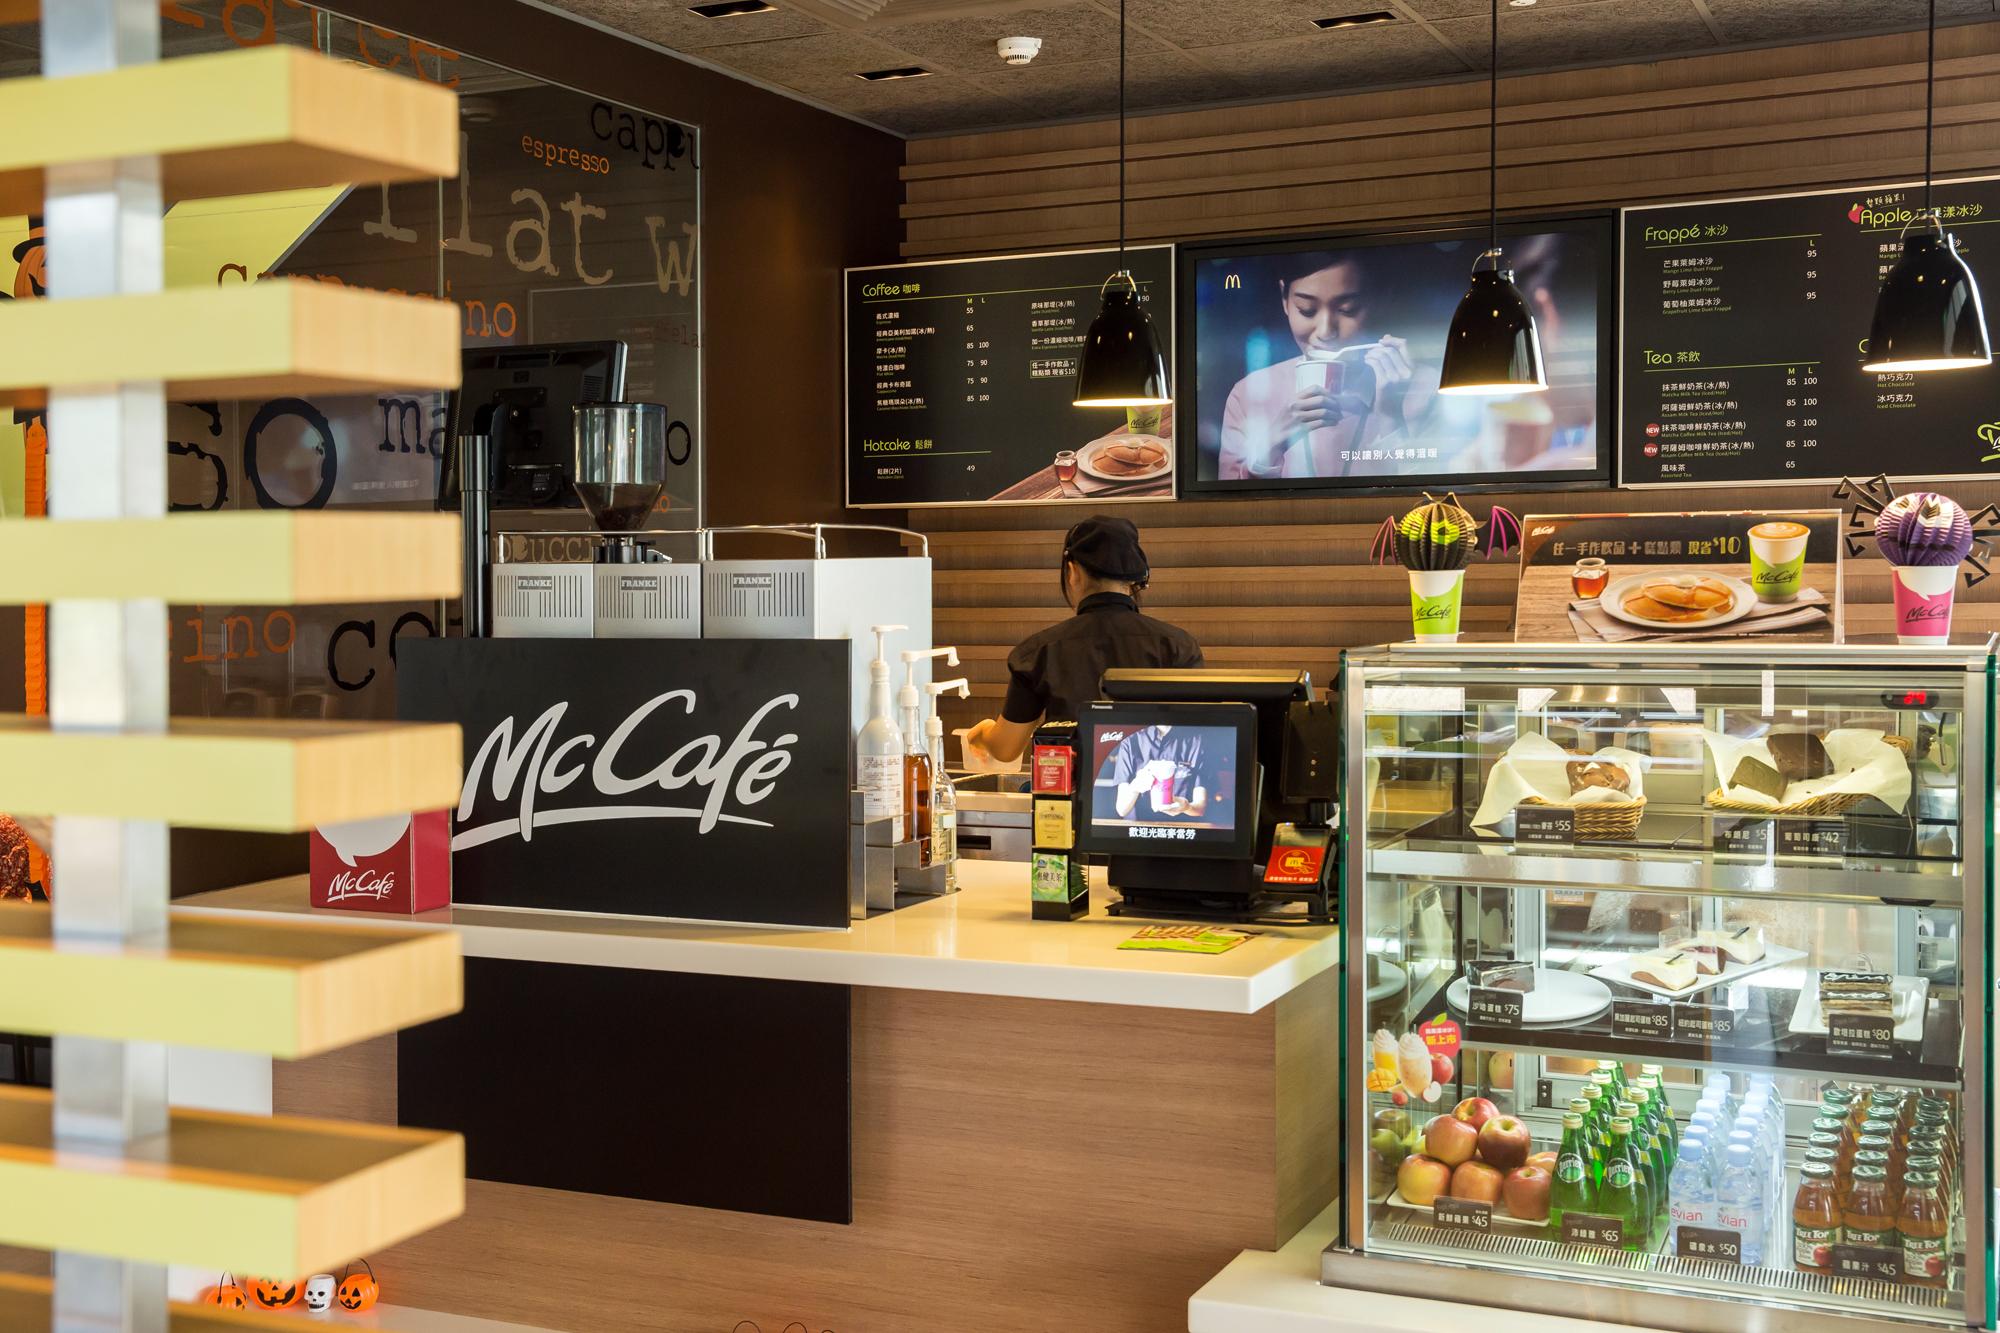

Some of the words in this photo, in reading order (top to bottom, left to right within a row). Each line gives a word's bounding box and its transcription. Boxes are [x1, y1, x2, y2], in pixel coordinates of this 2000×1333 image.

[522, 135, 610, 174] espresso
[1861, 207, 1912, 228] Apple
[1645, 224, 1700, 243] Frappé
[1705, 224, 1729, 237] 冰沙
[1663, 257, 1714, 268] 芒果萊姆冰沙
[1807, 250, 1817, 258] 95
[1806, 271, 1817, 279] 95
[862, 283, 900, 297] Coffee
[903, 284, 920, 294] 咖啡
[1806, 292, 1817, 300] 95
[1644, 350, 1672, 365] Tea
[1677, 351, 1700, 363] 茶飲
[1788, 367, 1795, 375] M
[1877, 373, 1914, 382] 熱巧克力
[1661, 381, 1730, 392] 抹茶鮮奶茶(冰/熱)
[1786, 378, 1797, 386] 85
[1804, 377, 1818, 385] 100
[1786, 399, 1797, 407] 85
[1803, 398, 1818, 406] 100
[1877, 393, 1914, 403] 冰巧克力
[1786, 419, 1796, 427] 85
[1803, 419, 1817, 427] 100
[1646, 426, 1660, 434] NEW
[863, 438, 911, 452] Hotcake
[915, 440, 933, 449] 鬆餅
[1644, 446, 1658, 454] NEW
[1785, 440, 1796, 448] 85
[1803, 439, 1817, 447] 100
[1340, 448, 1438, 461] 可以讓別人覺得溫暖
[1661, 463, 1686, 473] 風味茶
[1785, 460, 1796, 468] 65
[1553, 541, 1625, 556] 任一手作飲品
[1644, 540, 1682, 555] 糕點類
[518, 578, 552, 588] FRANKE
[621, 578, 657, 588] FRANKE
[733, 575, 772, 585] FRANKE
[454, 689, 800, 843] McCafé
[1555, 820, 1571, 831] $55
[1128, 827, 1196, 840] 歡迎光臨麥當勞
[1821, 832, 1839, 843] $42
[327, 869, 395, 903] McCafé
[1504, 1003, 1520, 1016] $75
[1651, 1014, 1668, 1027] $85
[1714, 1020, 1731, 1032] $85
[1872, 1028, 1890, 1040] $80
[1438, 1212, 1470, 1225] 新鮮蘋果
[1471, 1215, 1488, 1228] $45
[1671, 1207, 1703, 1221] evian
[1602, 1229, 1619, 1242] $65
[1720, 1243, 1737, 1256] $50
[1877, 1262, 1897, 1276] $45
